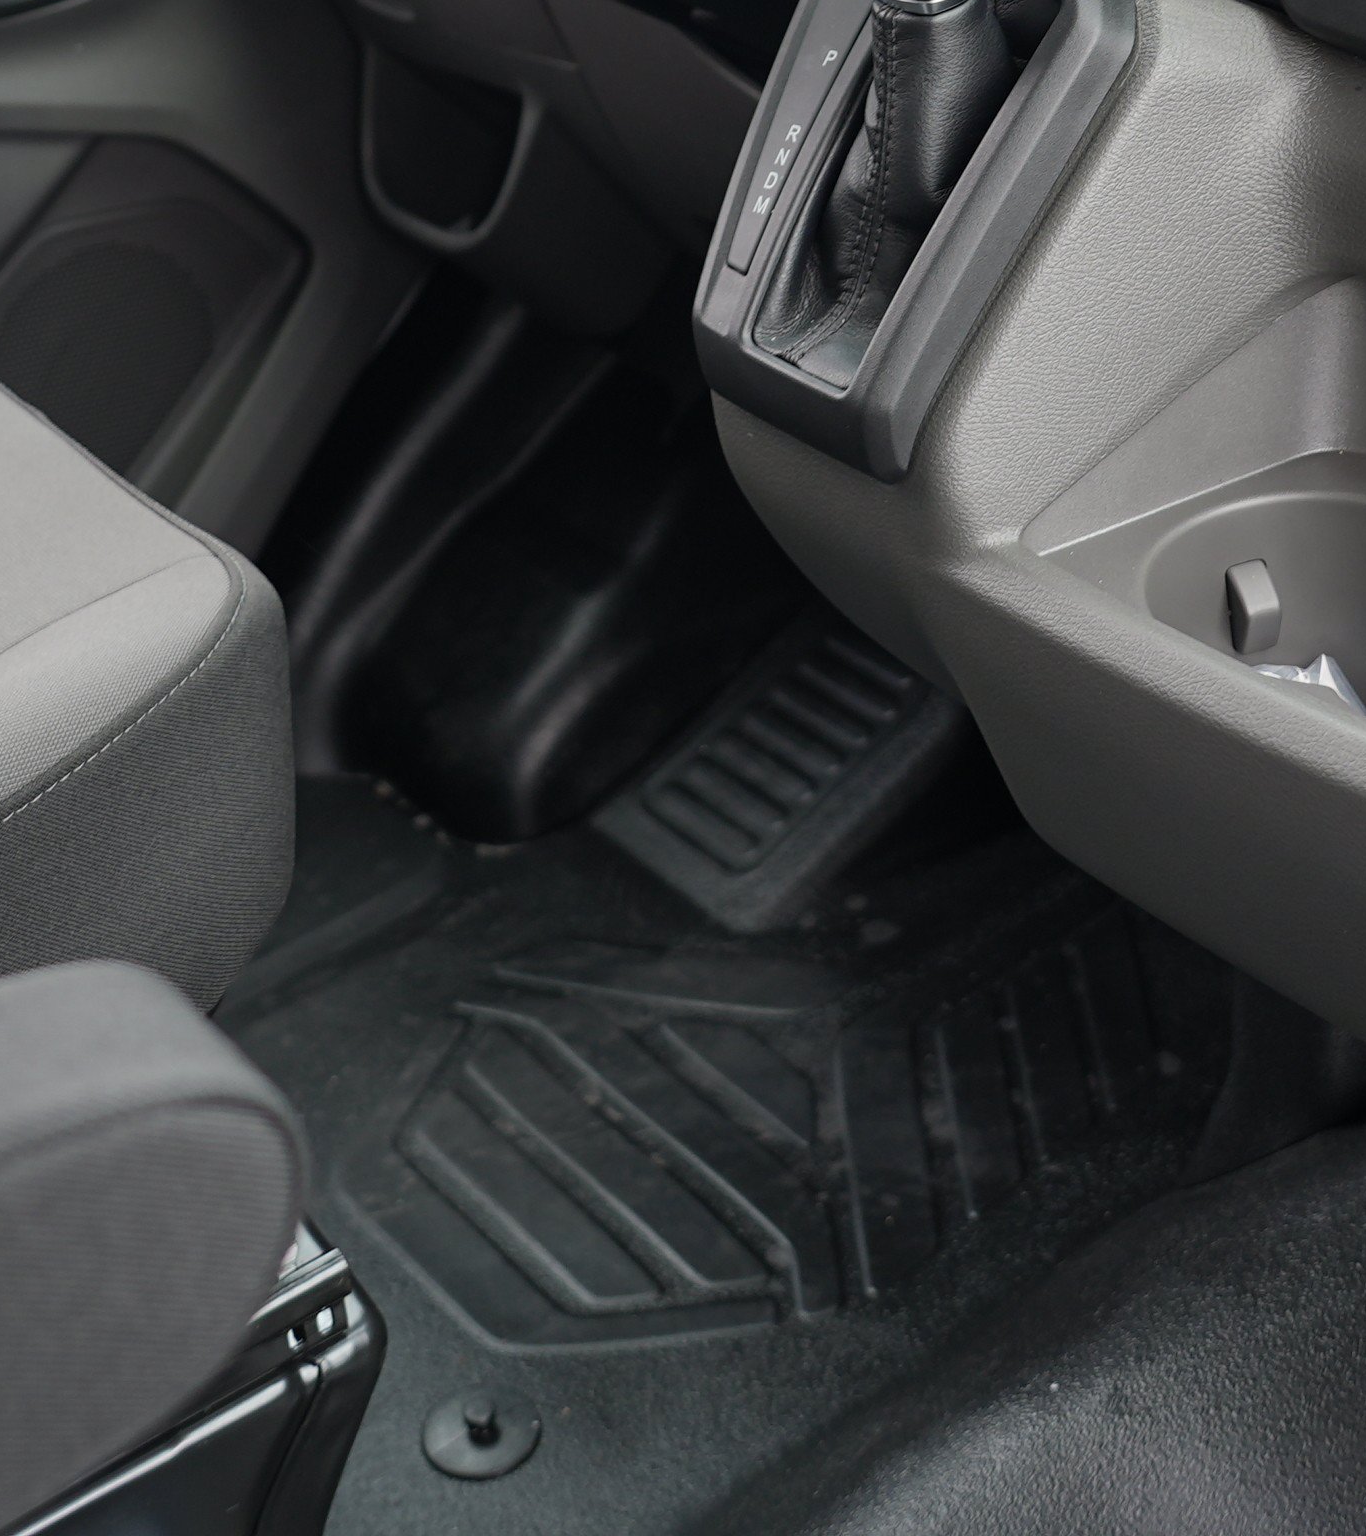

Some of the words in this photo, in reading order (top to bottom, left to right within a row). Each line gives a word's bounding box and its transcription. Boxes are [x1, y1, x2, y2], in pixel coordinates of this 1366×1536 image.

[822, 49, 838, 67] P
[785, 124, 802, 144] R
[774, 147, 791, 167] N
[763, 170, 779, 190] D
[752, 195, 771, 215] M
